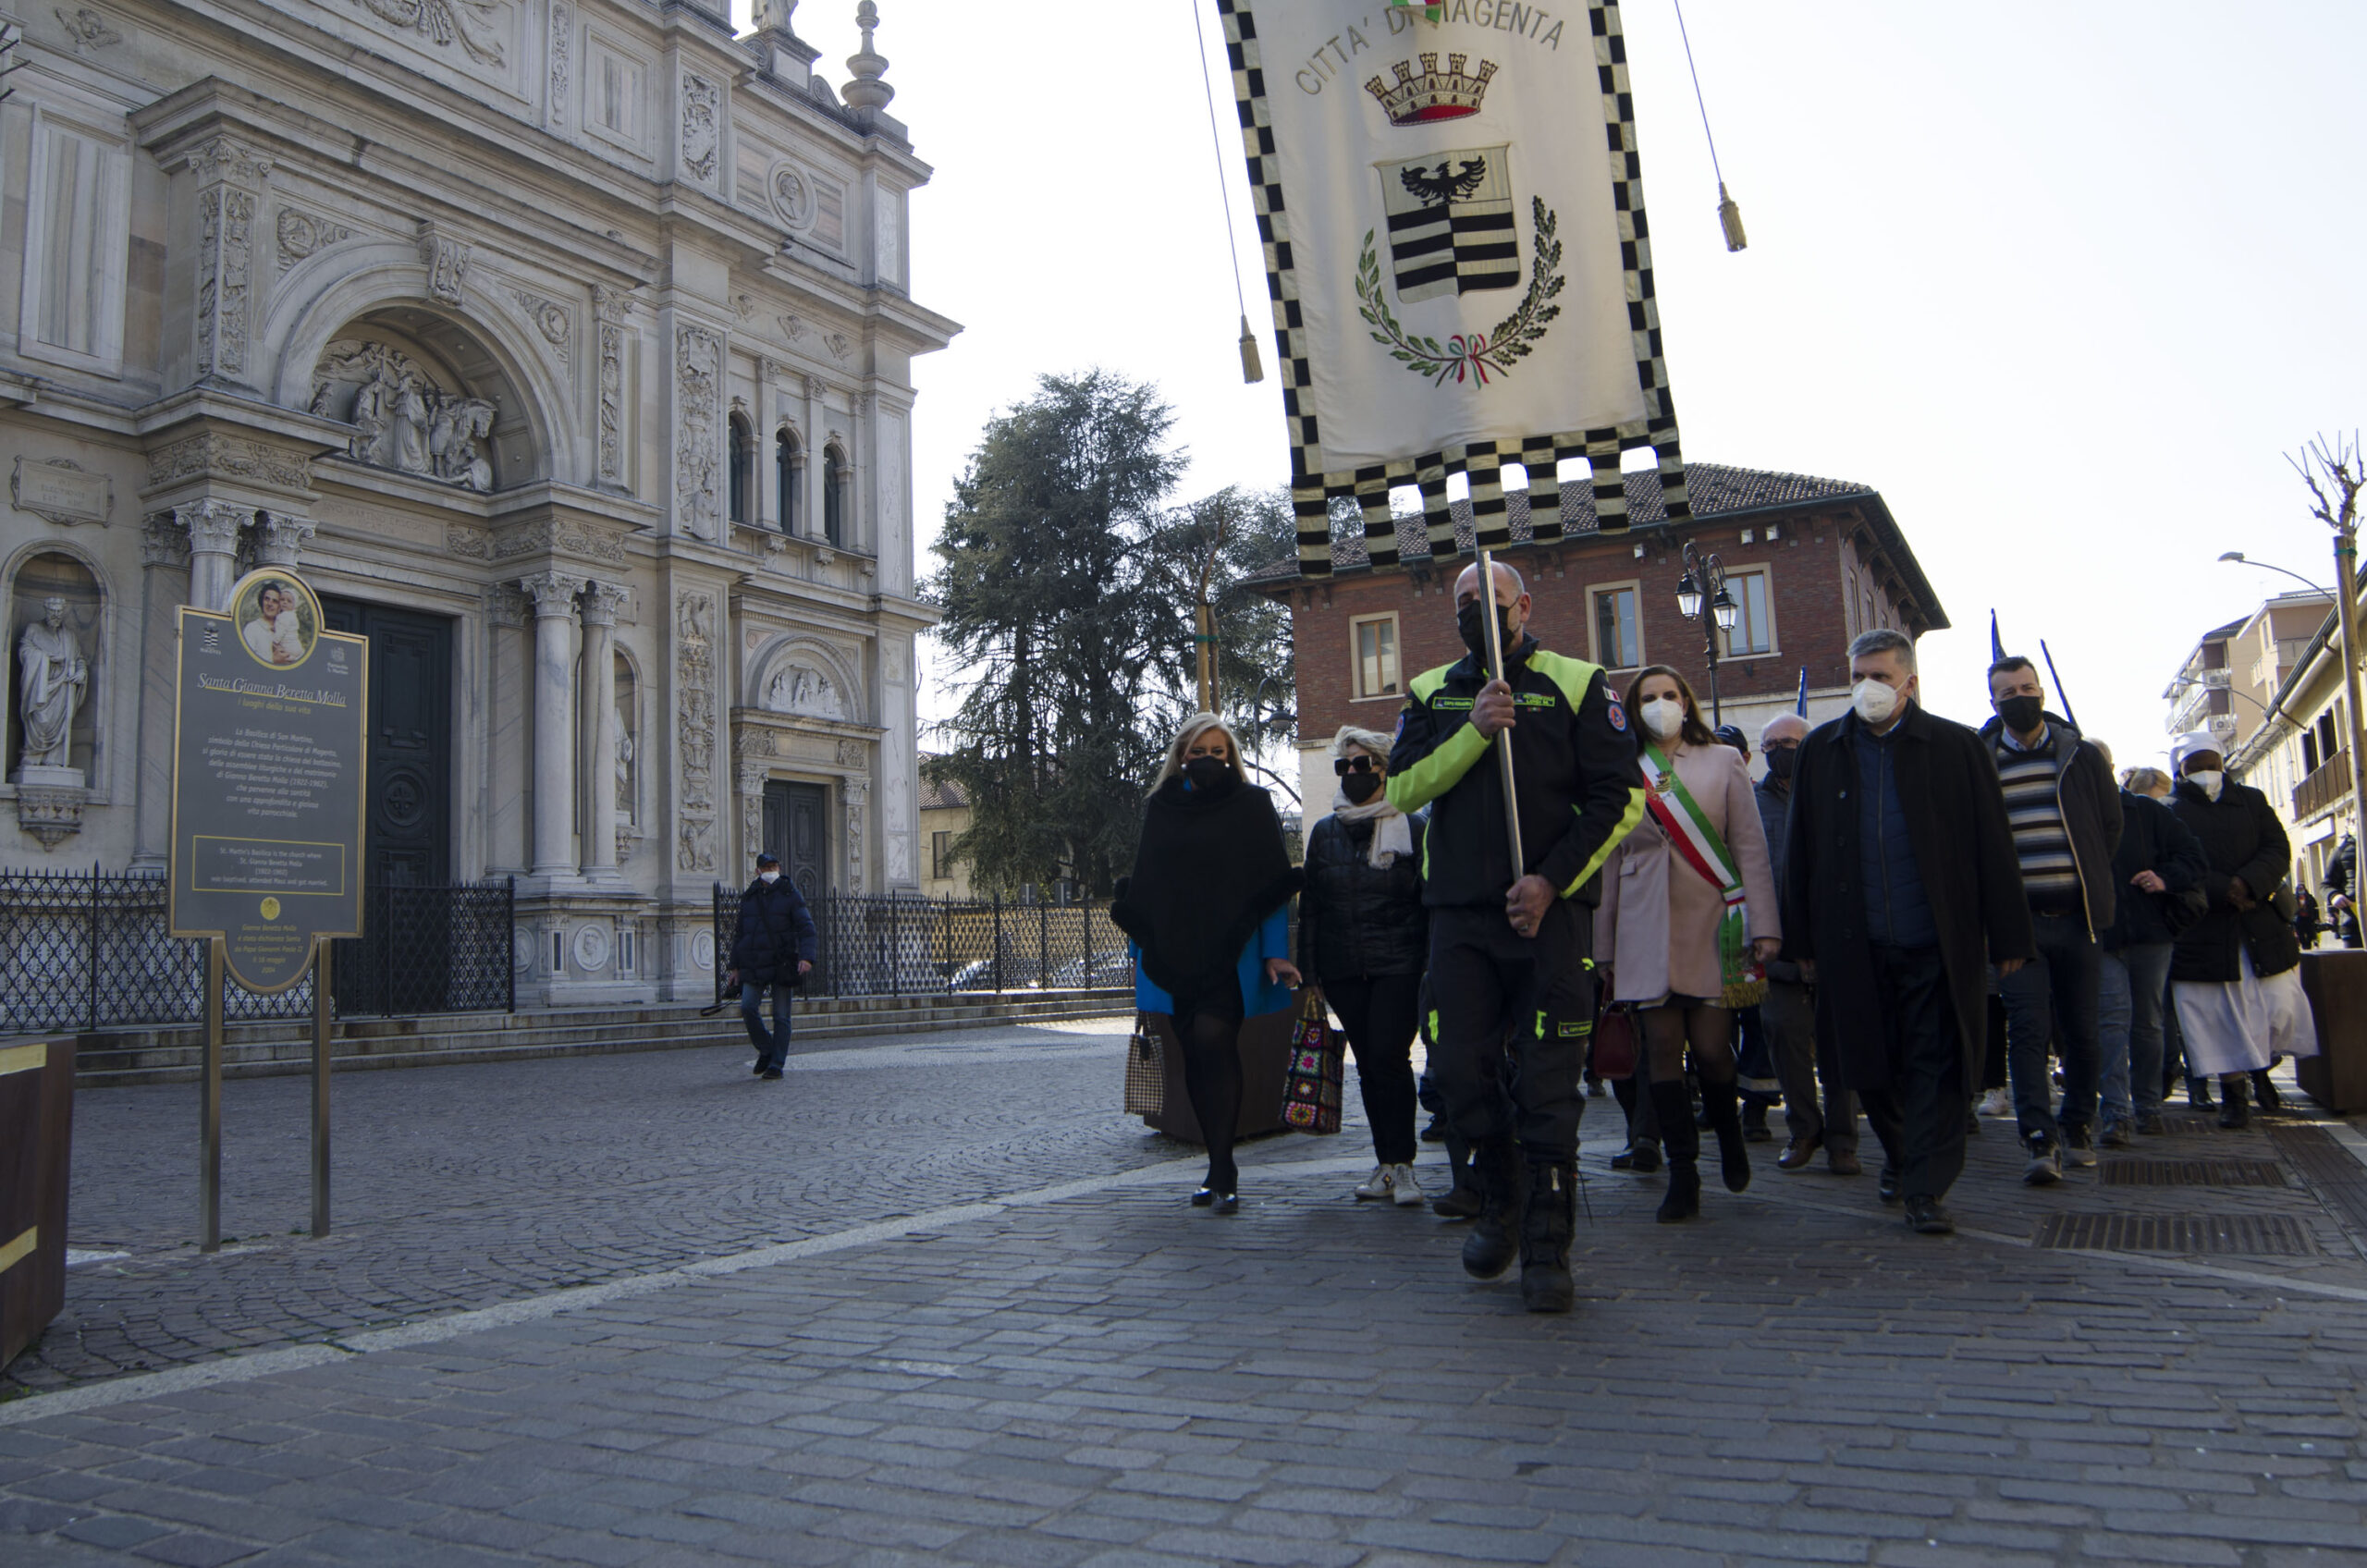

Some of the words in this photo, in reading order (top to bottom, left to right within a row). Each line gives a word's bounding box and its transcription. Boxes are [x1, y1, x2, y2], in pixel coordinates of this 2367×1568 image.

[1295, 16, 1370, 95] CITTA'
[1442, 0, 1564, 51] AGENTA
[197, 672, 230, 689] Santa
[232, 678, 275, 695] Gianna
[276, 684, 314, 701] Beretta
[315, 690, 347, 704] Molla
[242, 698, 264, 711] luoghi
[265, 702, 283, 711] della
[284, 704, 297, 713] sua
[298, 705, 311, 715] vita
[245, 729, 268, 739] Basilica
[251, 740, 271, 750] Chiesa
[238, 751, 257, 759] essere
[225, 770, 247, 780] Gianna
[248, 773, 271, 783] Beretta
[273, 776, 288, 785] Molla
